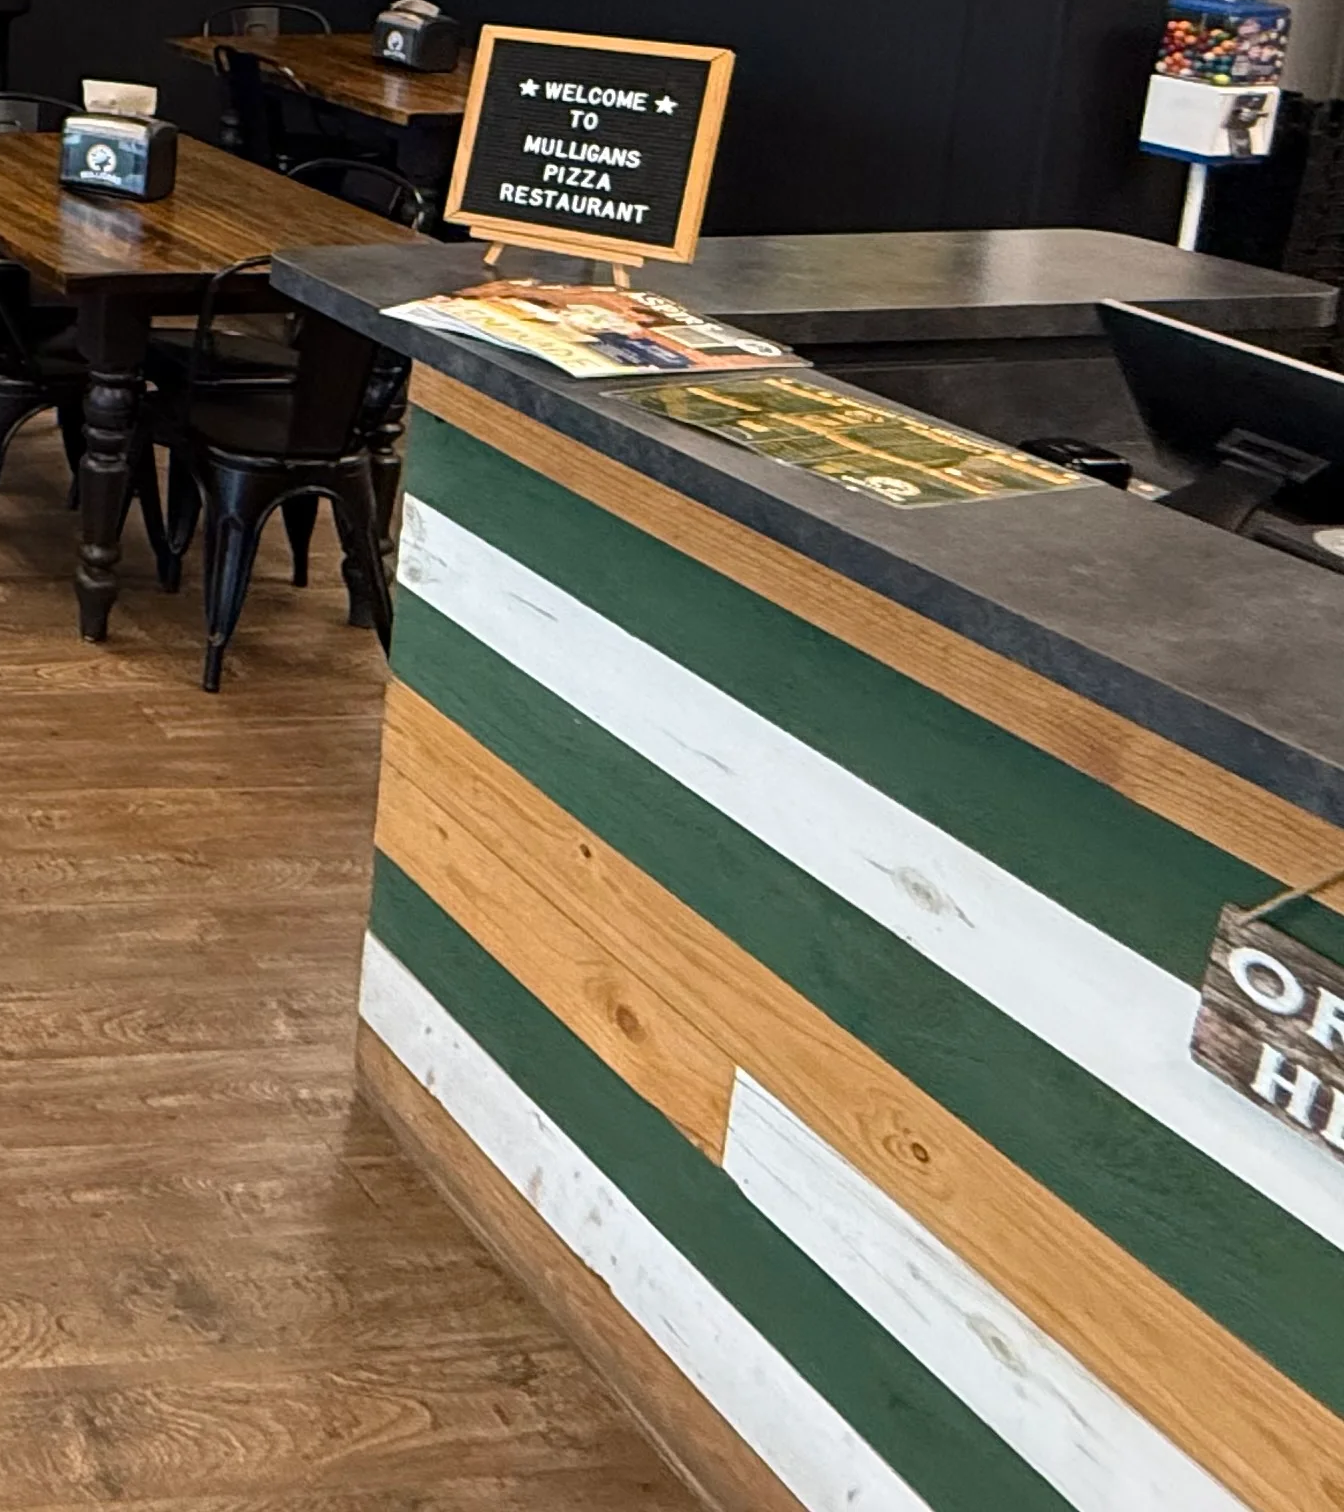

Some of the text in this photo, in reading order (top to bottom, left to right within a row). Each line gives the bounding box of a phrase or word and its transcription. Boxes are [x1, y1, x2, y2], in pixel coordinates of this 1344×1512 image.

[544, 81, 650, 112] WELCOME
[569, 109, 599, 130] TO
[523, 134, 643, 169] MULLIGANS
[542, 164, 612, 192] PIZZA
[499, 182, 651, 224] RESTAURANT
